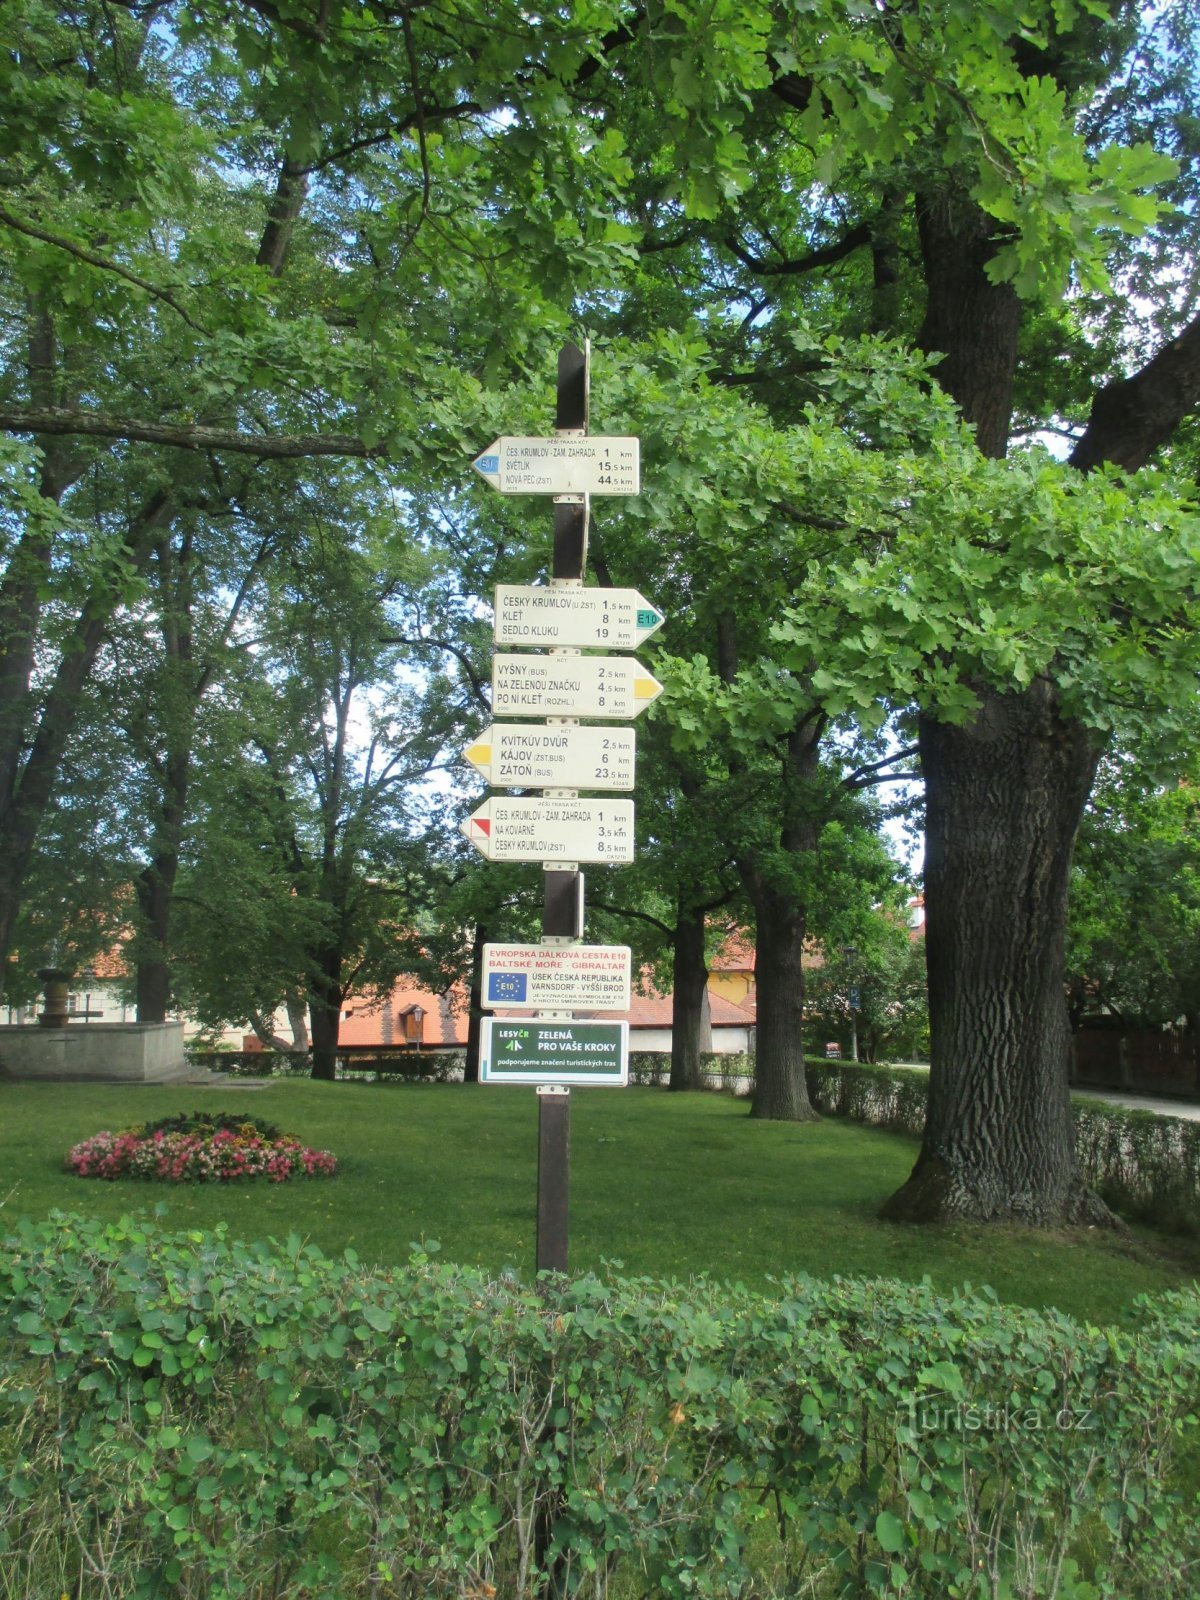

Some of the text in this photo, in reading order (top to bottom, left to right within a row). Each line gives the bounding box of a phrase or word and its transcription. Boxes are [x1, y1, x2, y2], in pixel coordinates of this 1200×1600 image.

[521, 448, 549, 456] KRUMLOV
[568, 448, 595, 457] ZAHRADA
[604, 448, 609, 457] 1
[599, 462, 618, 471] 15,5
[598, 476, 618, 485] 44,5
[532, 598, 571, 608] KRUMLOV
[603, 615, 608, 623] 8
[638, 615, 657, 624] E10
[503, 625, 529, 635] SEDLO
[532, 627, 558, 636] KLUKU
[596, 629, 608, 637] 19
[528, 668, 547, 676] (BUS)
[498, 681, 508, 689] NA
[511, 681, 546, 690] ZELENOU
[549, 679, 580, 691] ZNAČKU
[497, 694, 509, 703] PO
[598, 697, 605, 706] 8
[602, 754, 608, 763] 6
[535, 769, 553, 777] (BUS)
[595, 768, 615, 779] 23,5
[511, 811, 542, 820] KRUMLOV
[562, 811, 591, 821] ZAHRADA
[598, 812, 603, 821] 1
[495, 826, 504, 835] NA
[598, 827, 612, 837] 3,5
[517, 840, 547, 850] KRUMLOV
[598, 842, 611, 852] 8,5
[538, 1030, 572, 1039] ZELENÁ
[559, 1042, 582, 1051] VAŠE
[584, 1043, 616, 1051] KROKY
[567, 1059, 603, 1067] turistických
